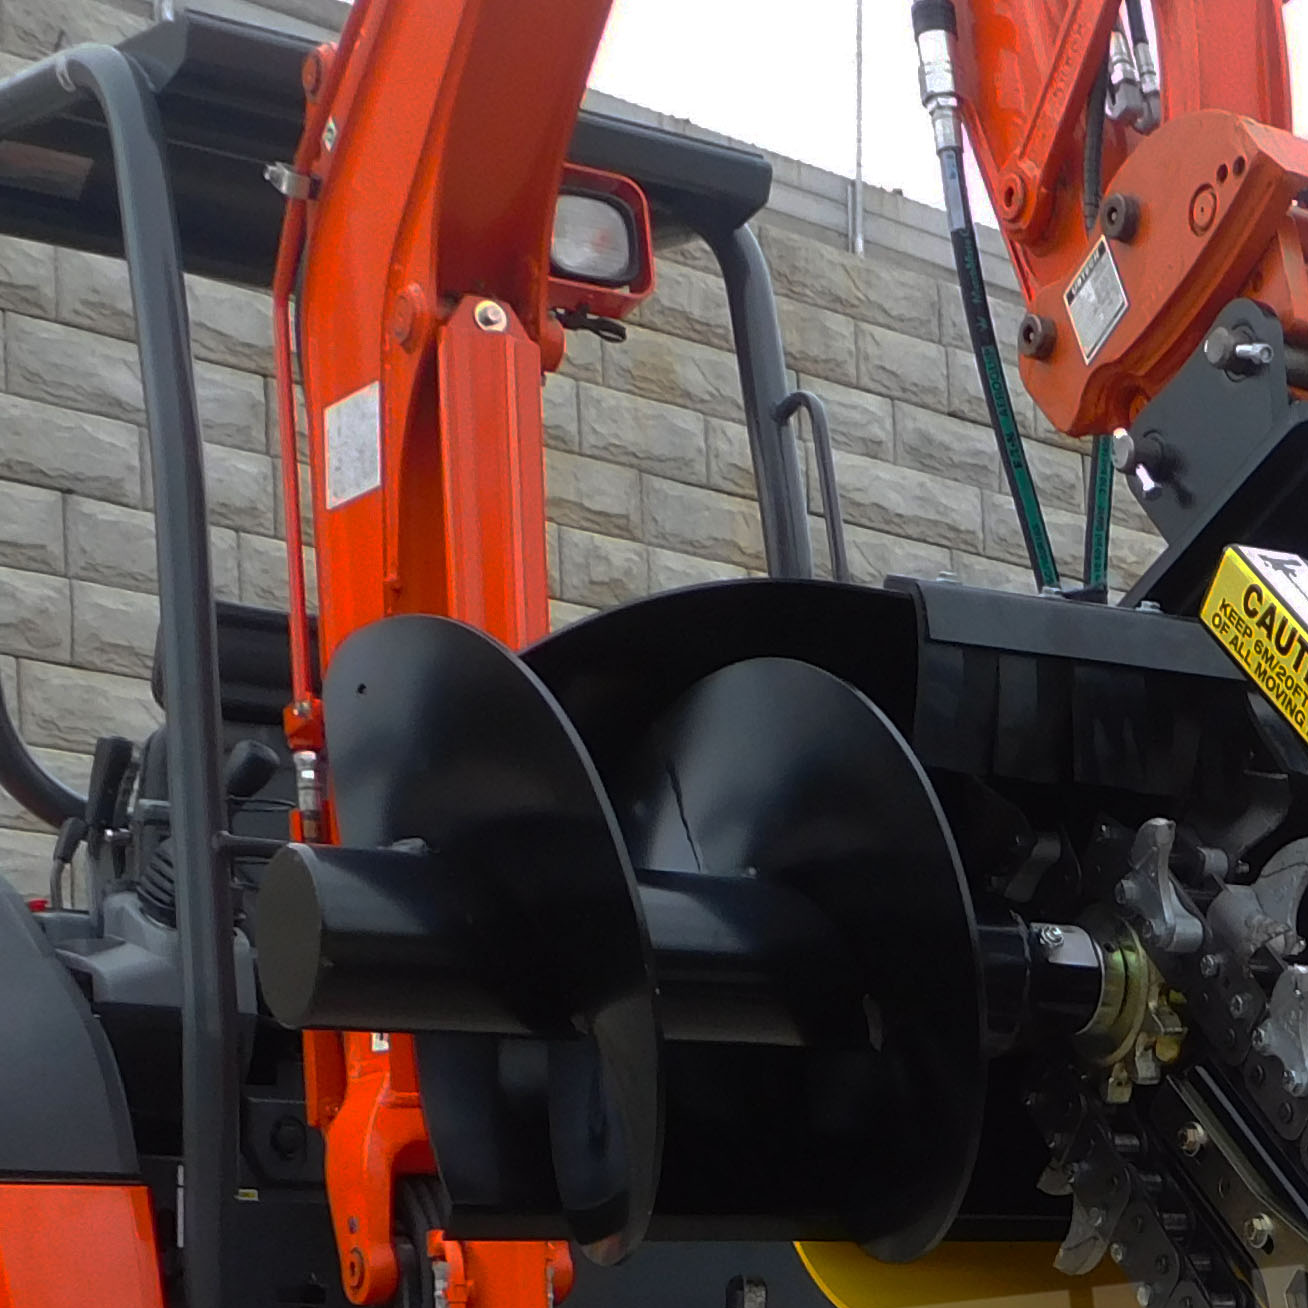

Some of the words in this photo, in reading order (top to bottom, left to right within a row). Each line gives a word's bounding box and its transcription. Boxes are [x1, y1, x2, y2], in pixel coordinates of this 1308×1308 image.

[1219, 598, 1253, 638] KEEP
[1211, 612, 1230, 635] OF
[1229, 635, 1251, 666] ALL
[1254, 661, 1305, 729] MOVING
